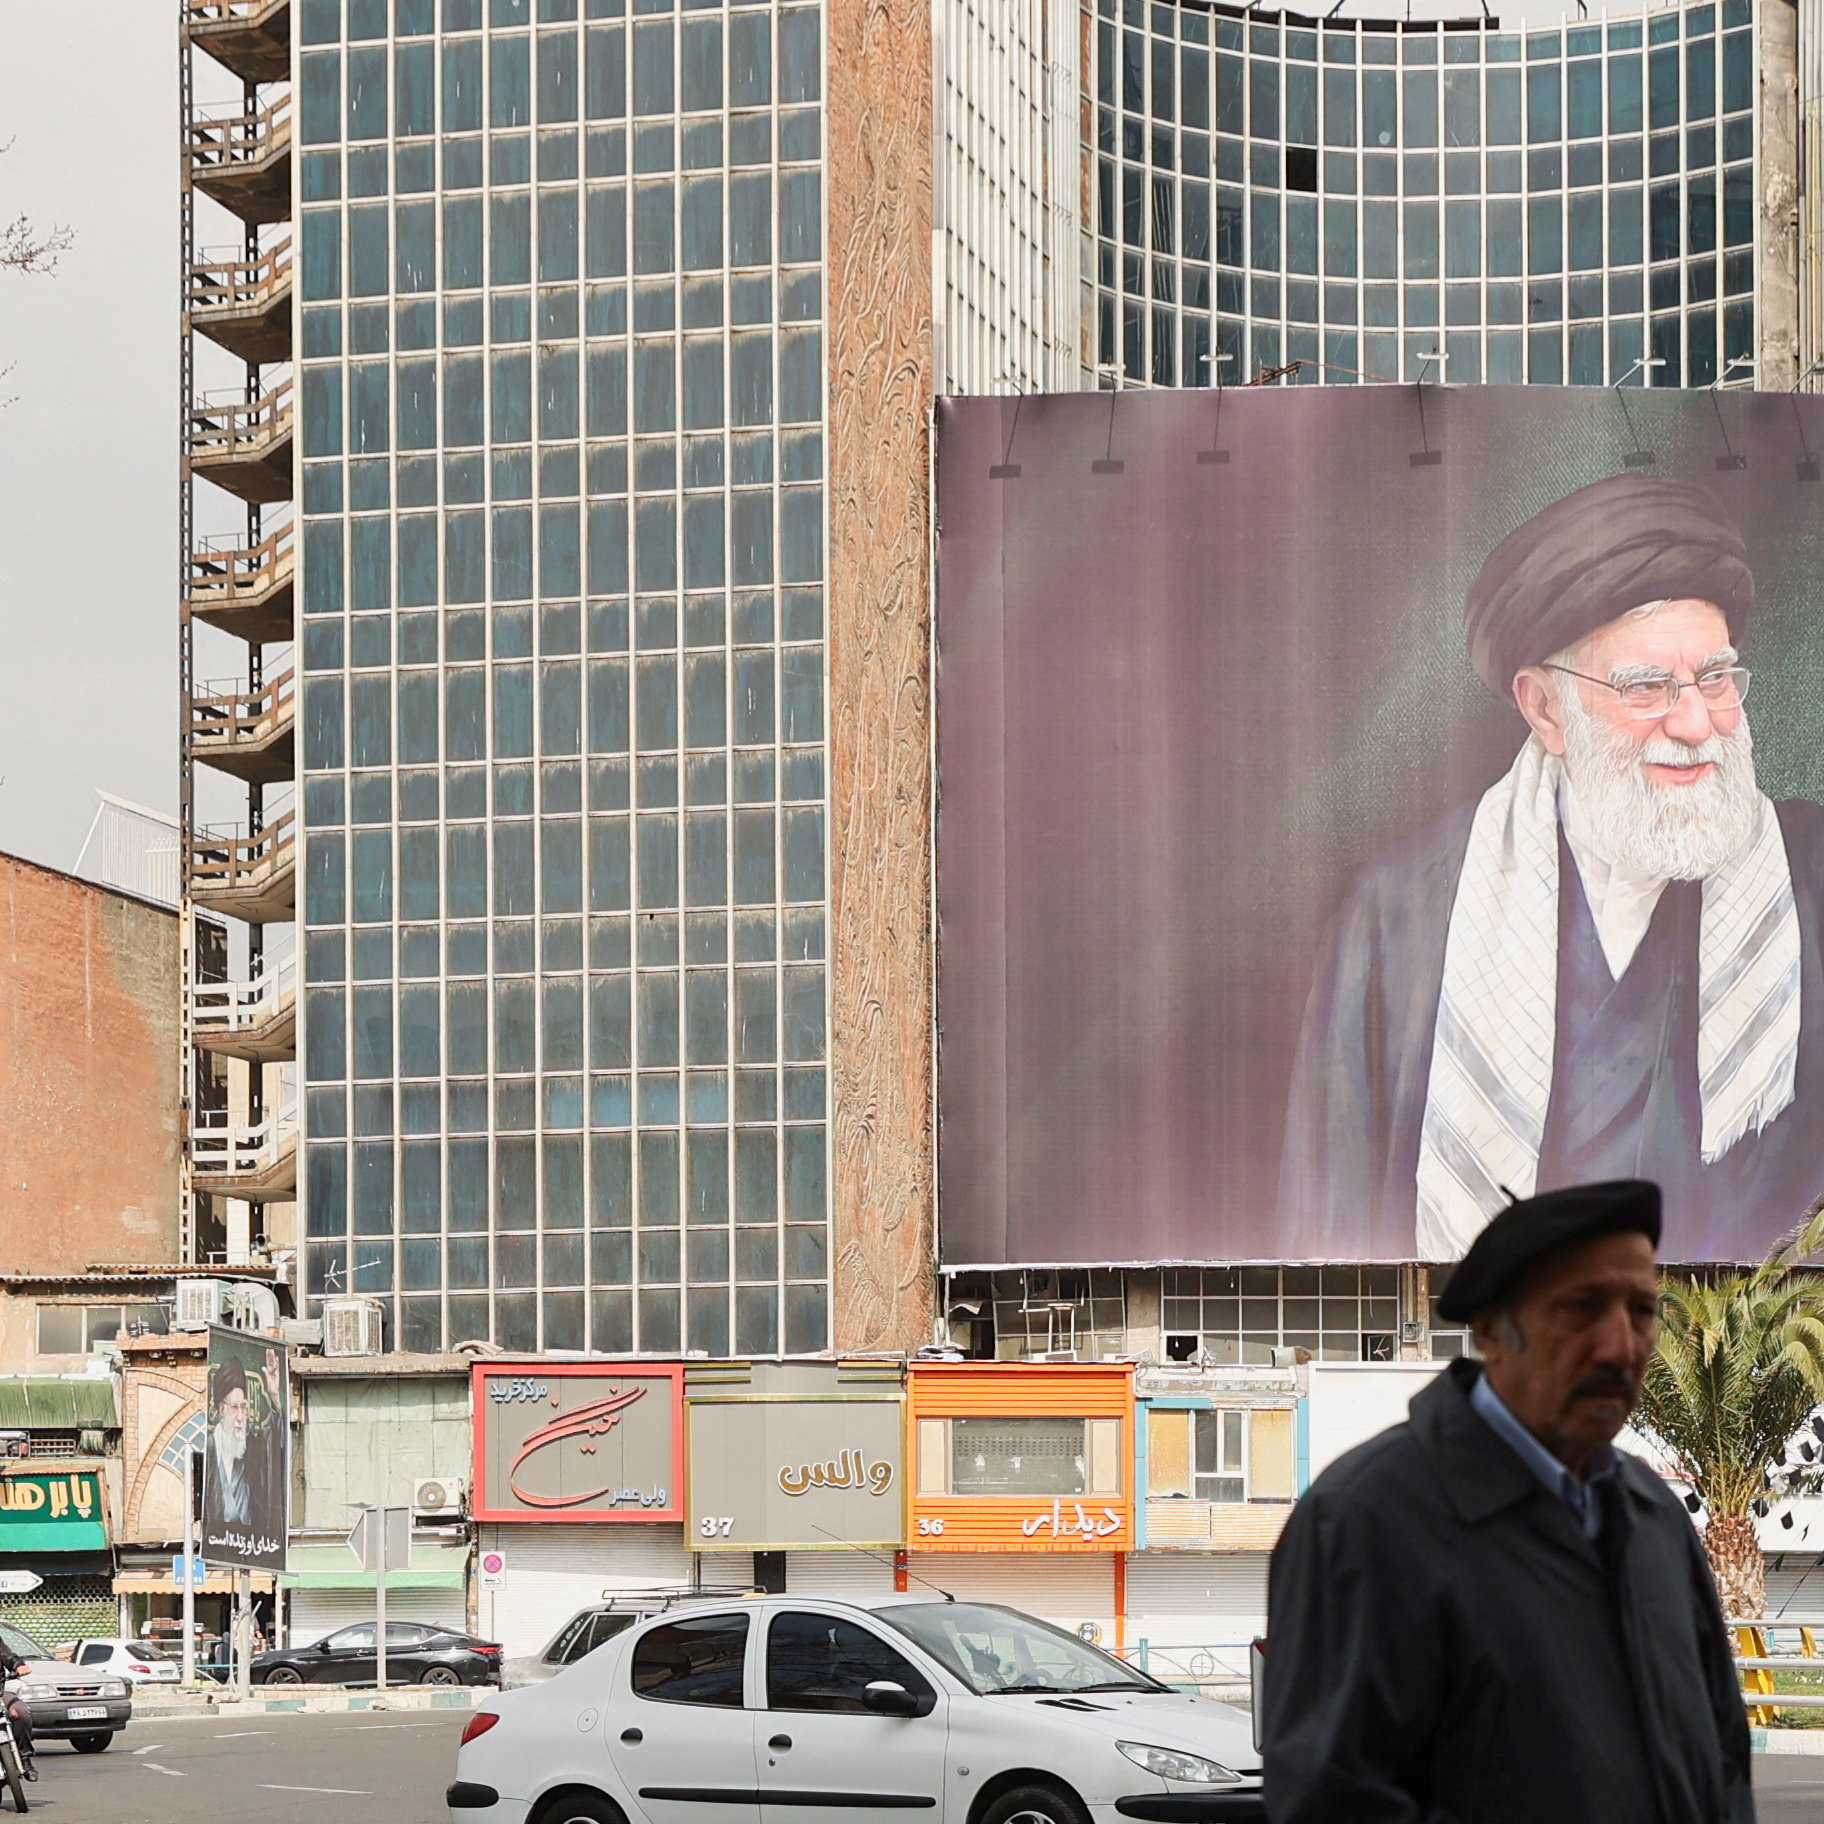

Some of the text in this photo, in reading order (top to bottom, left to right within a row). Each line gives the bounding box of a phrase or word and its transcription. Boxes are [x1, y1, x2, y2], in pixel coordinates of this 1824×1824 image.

[777, 1448, 894, 1496] والس
[700, 1516, 736, 1537] 37
[917, 1517, 945, 1536] 36
